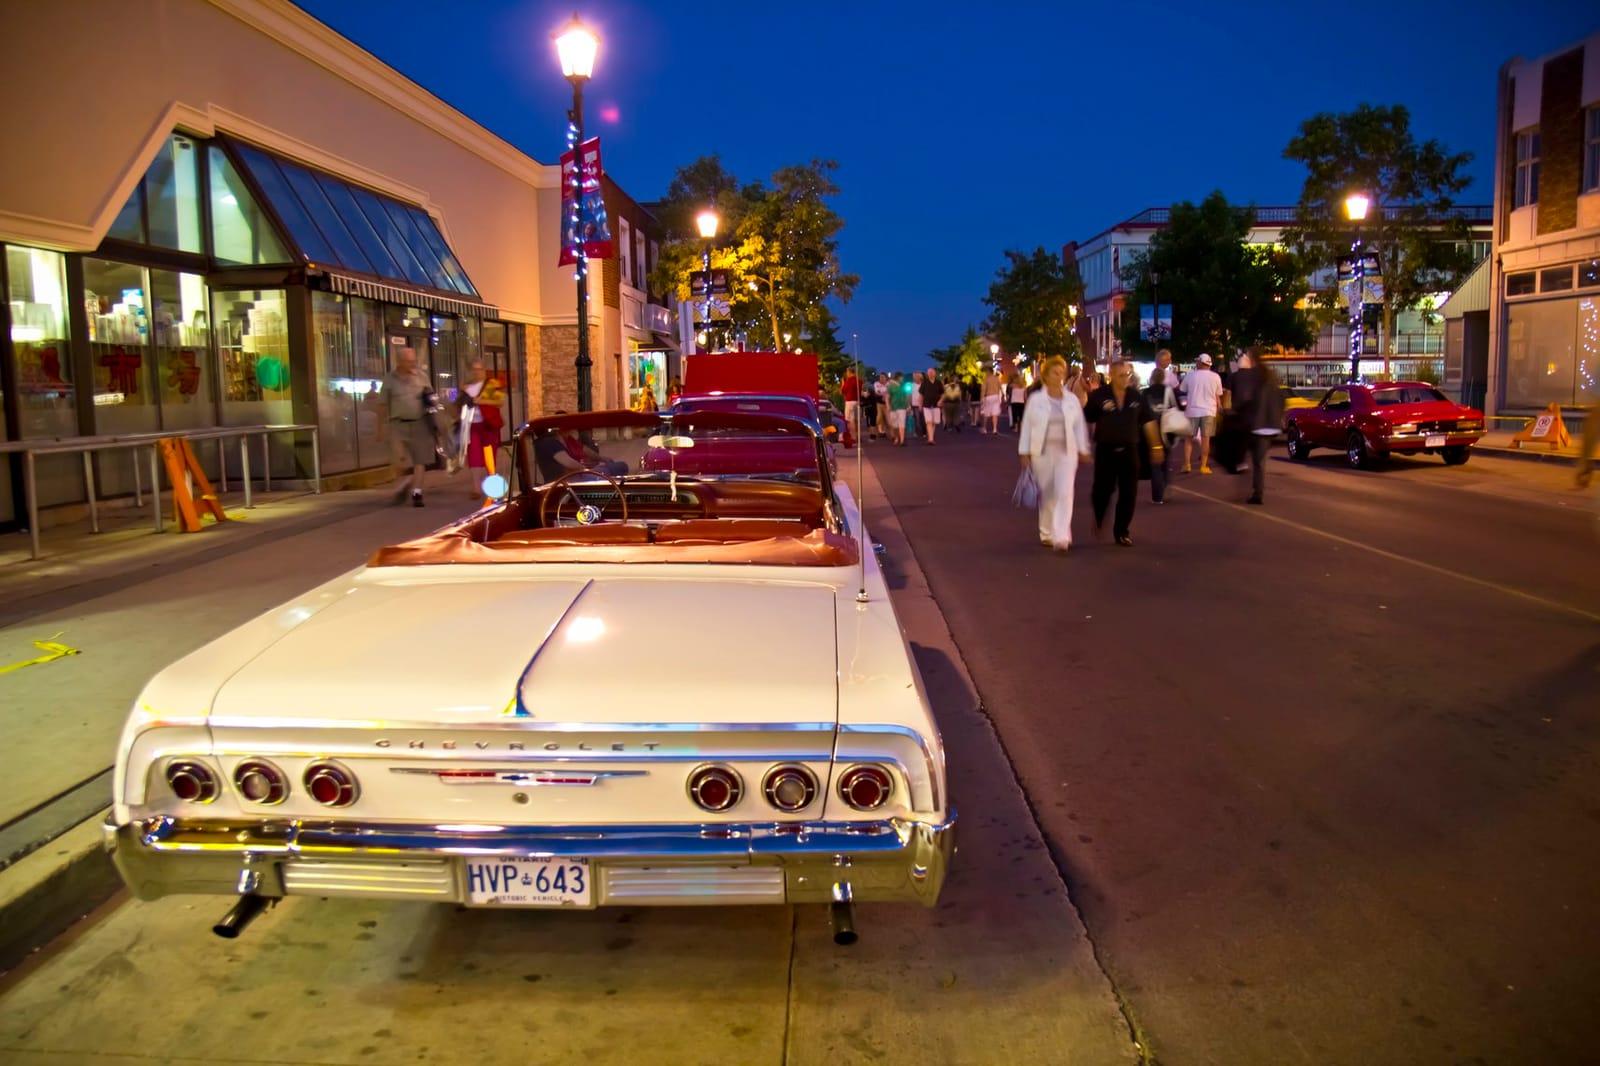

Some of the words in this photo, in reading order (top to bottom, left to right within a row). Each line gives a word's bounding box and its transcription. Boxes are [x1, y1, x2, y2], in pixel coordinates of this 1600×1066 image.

[375, 739, 659, 751] CHEVROLET
[468, 864, 518, 893] HVP
[536, 866, 585, 894] 643
